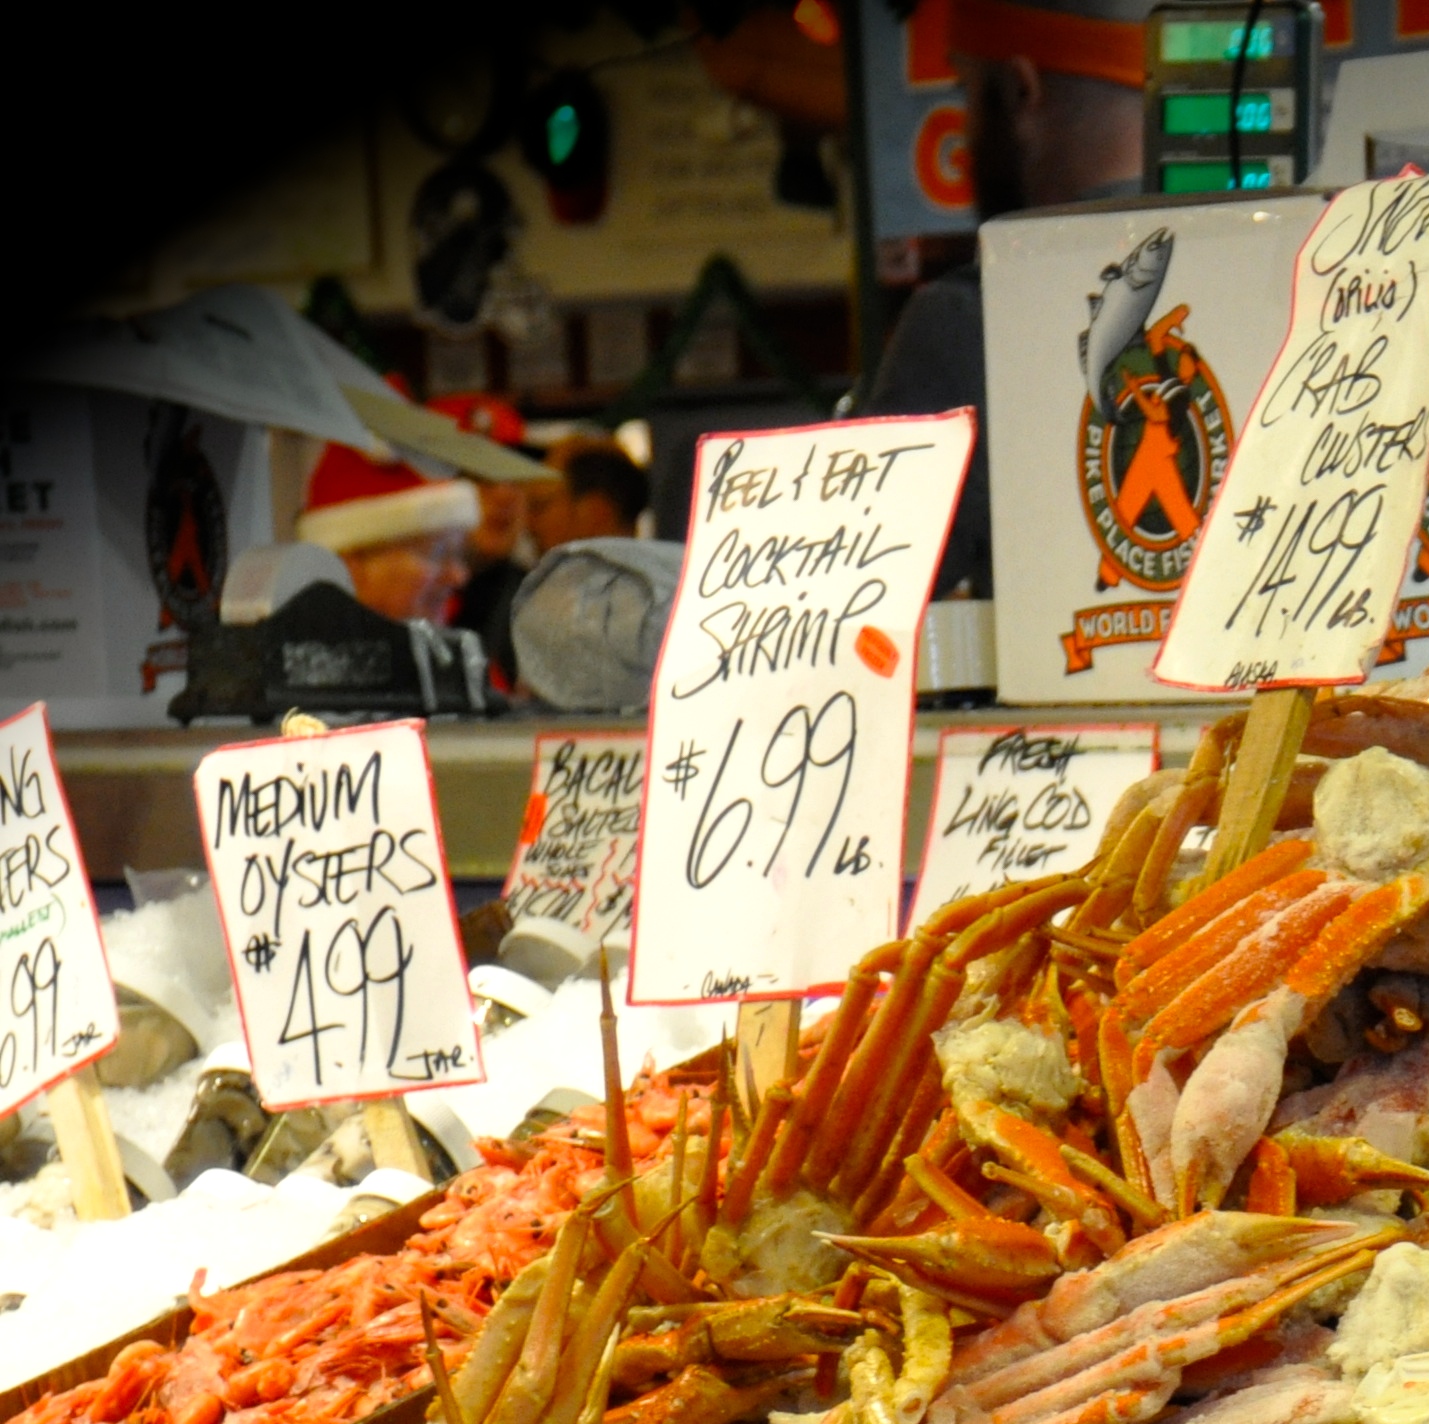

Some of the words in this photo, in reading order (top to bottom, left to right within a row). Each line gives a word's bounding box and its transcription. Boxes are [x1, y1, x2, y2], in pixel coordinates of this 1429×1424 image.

[1261, 331, 1389, 428] CRAB
[707, 438, 782, 523] PEEL
[820, 444, 935, 502] EAT
[1086, 424, 1105, 503] PIKE
[1096, 509, 1155, 576] PLACE
[699, 506, 912, 598] COCKTAIL
[1226, 484, 1388, 638] $14.99
[671, 578, 887, 700] SHRIMP
[1079, 610, 1154, 639] WORLD
[543, 739, 644, 805] BACAL
[662, 691, 857, 890] $6.99
[978, 727, 1088, 777] FRESH
[215, 750, 381, 850] MEDIUM
[943, 784, 1020, 838] LING
[1023, 781, 1092, 831] COD
[0, 825, 70, 913] ERS
[241, 829, 437, 940] OYSTERS
[977, 834, 1067, 871] FILLET
[242, 905, 414, 1086] $4.99
